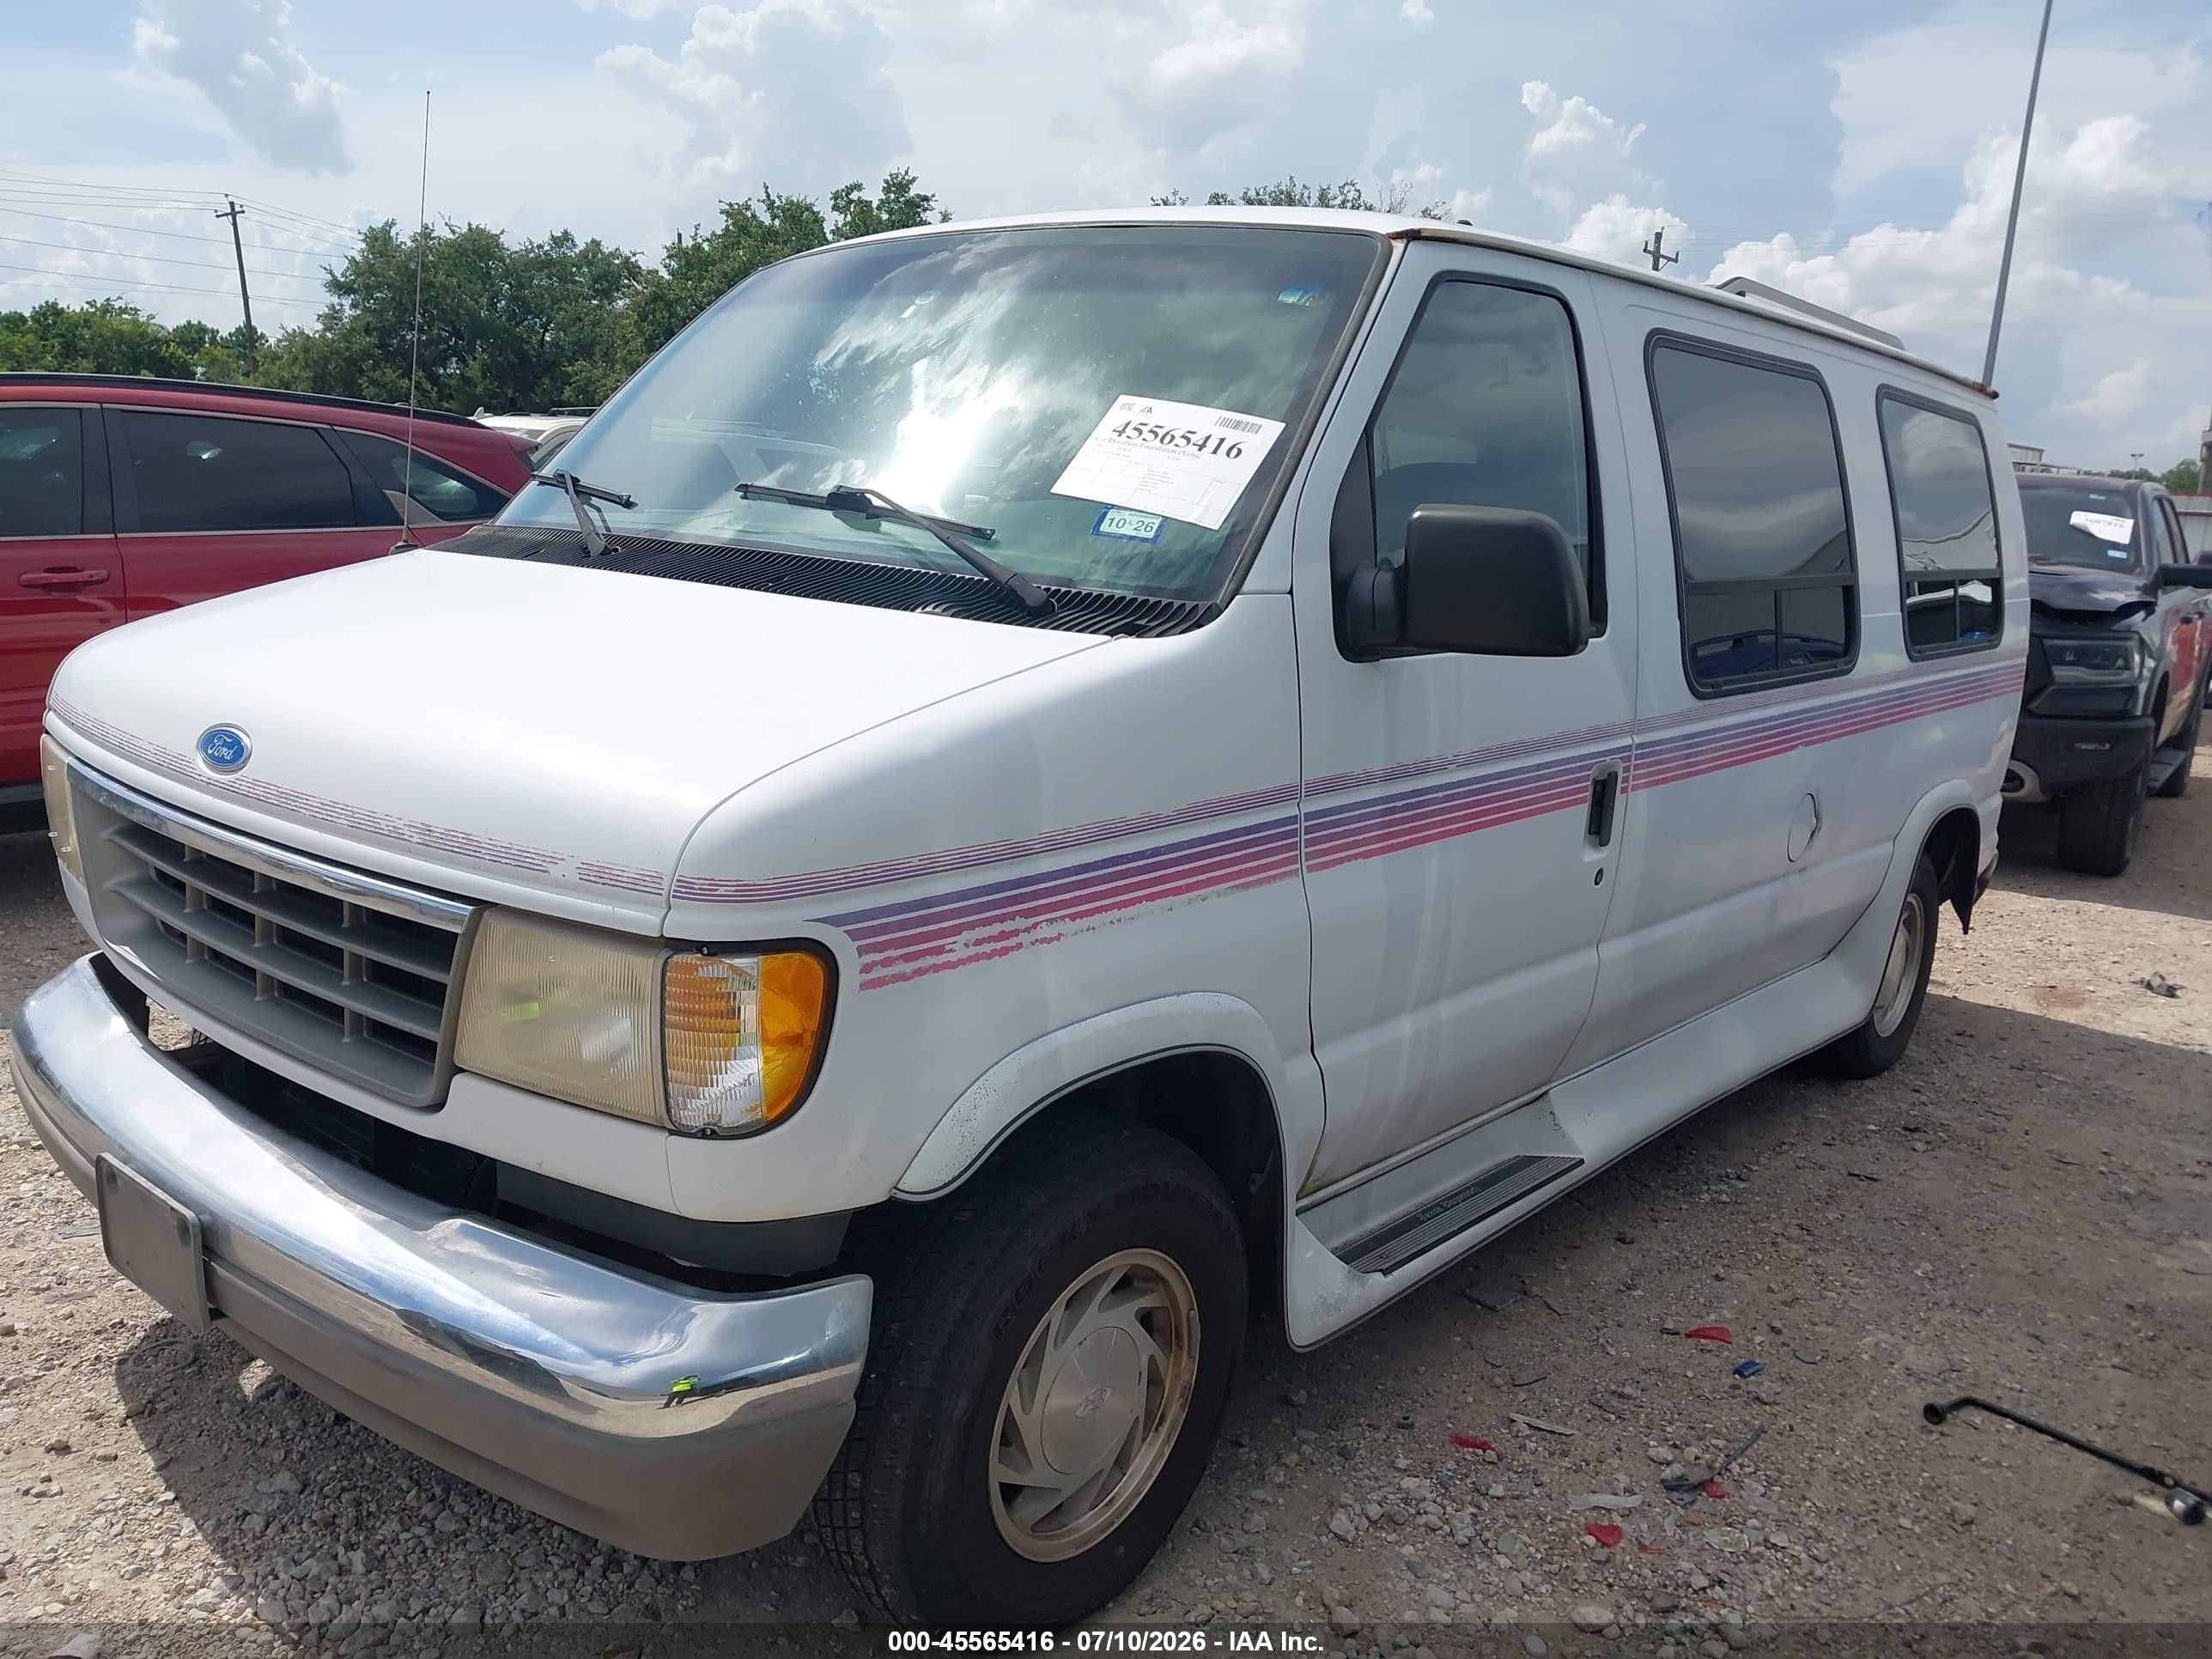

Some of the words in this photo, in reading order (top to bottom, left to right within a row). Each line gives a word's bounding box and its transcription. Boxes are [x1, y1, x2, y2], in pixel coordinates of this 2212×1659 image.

[1112, 420, 1249, 459] 45565416
[1108, 517, 1127, 529] 10
[1133, 520, 1155, 532] 26
[208, 734, 237, 760] Ford
